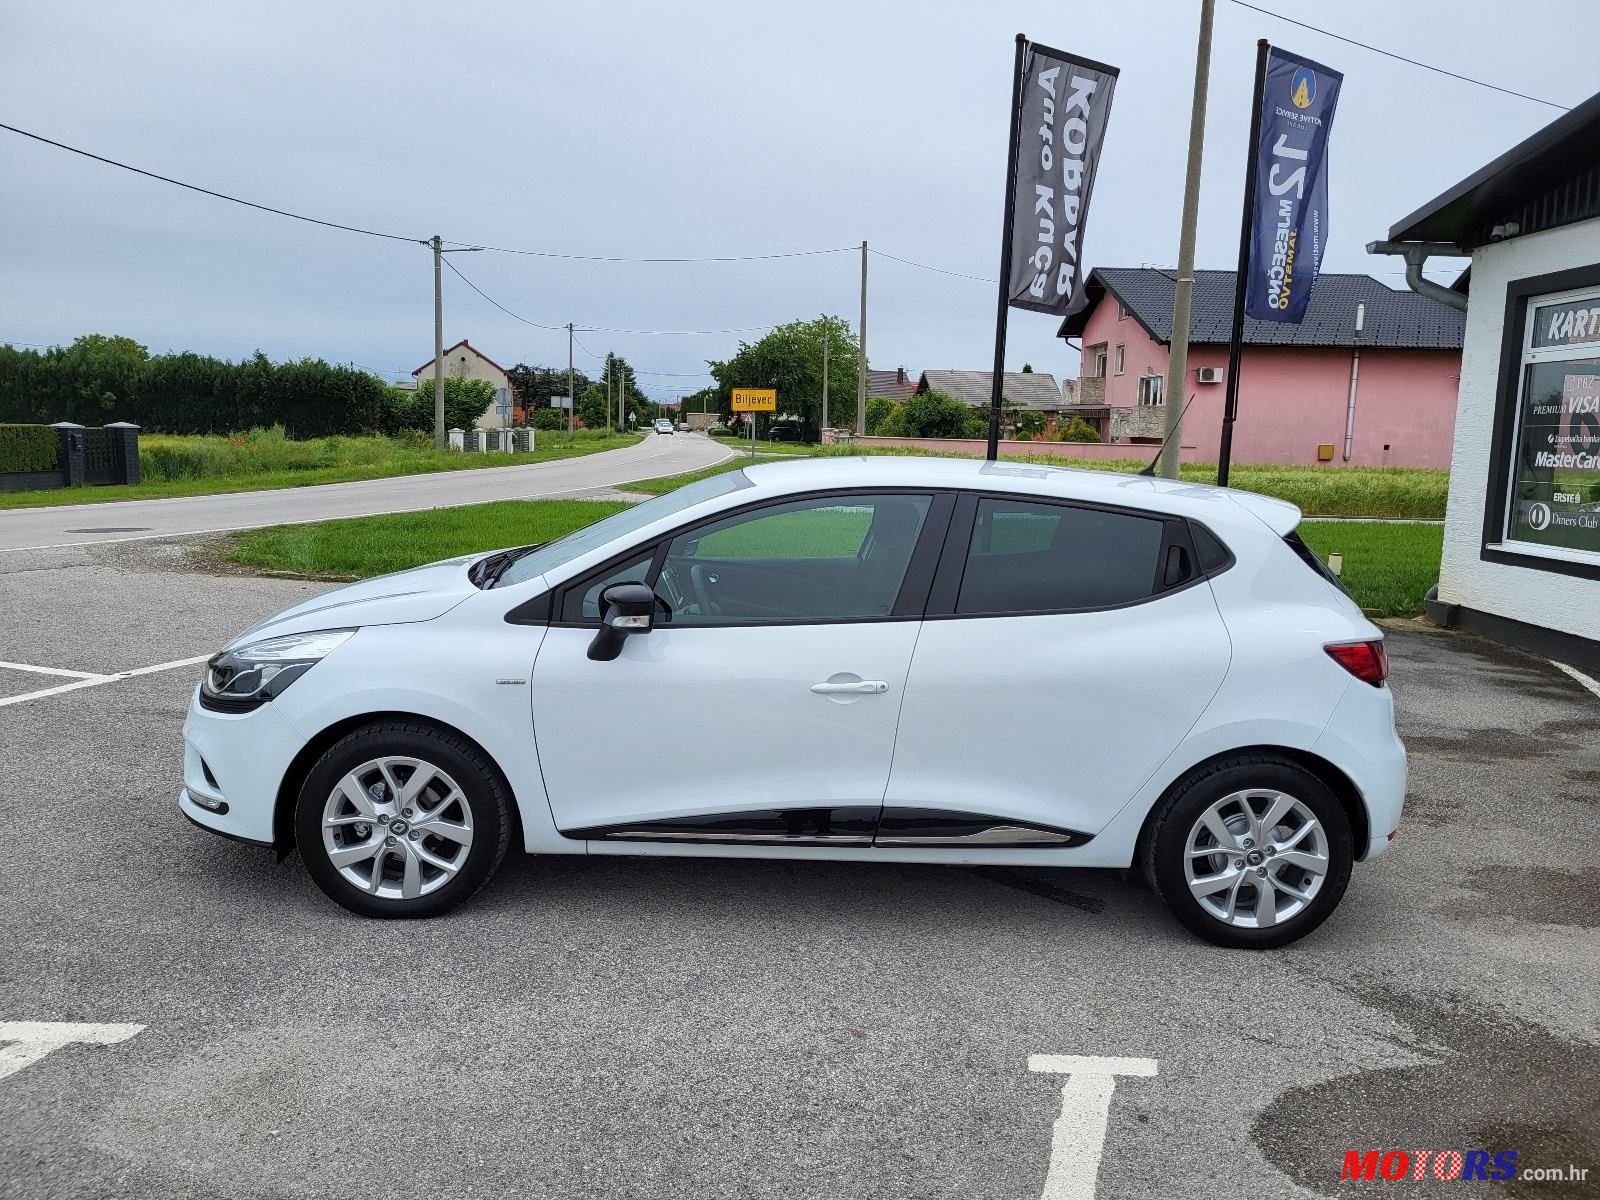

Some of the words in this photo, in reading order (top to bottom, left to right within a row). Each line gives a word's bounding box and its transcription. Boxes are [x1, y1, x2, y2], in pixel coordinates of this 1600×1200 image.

[735, 393, 772, 406] Biljevec
[1533, 405, 1567, 415] PREMIUM
[1568, 396, 1600, 414] VISA
[1553, 492, 1575, 503] ERSTE
[1552, 512, 1577, 527] Diners
[1578, 516, 1599, 529] Club
